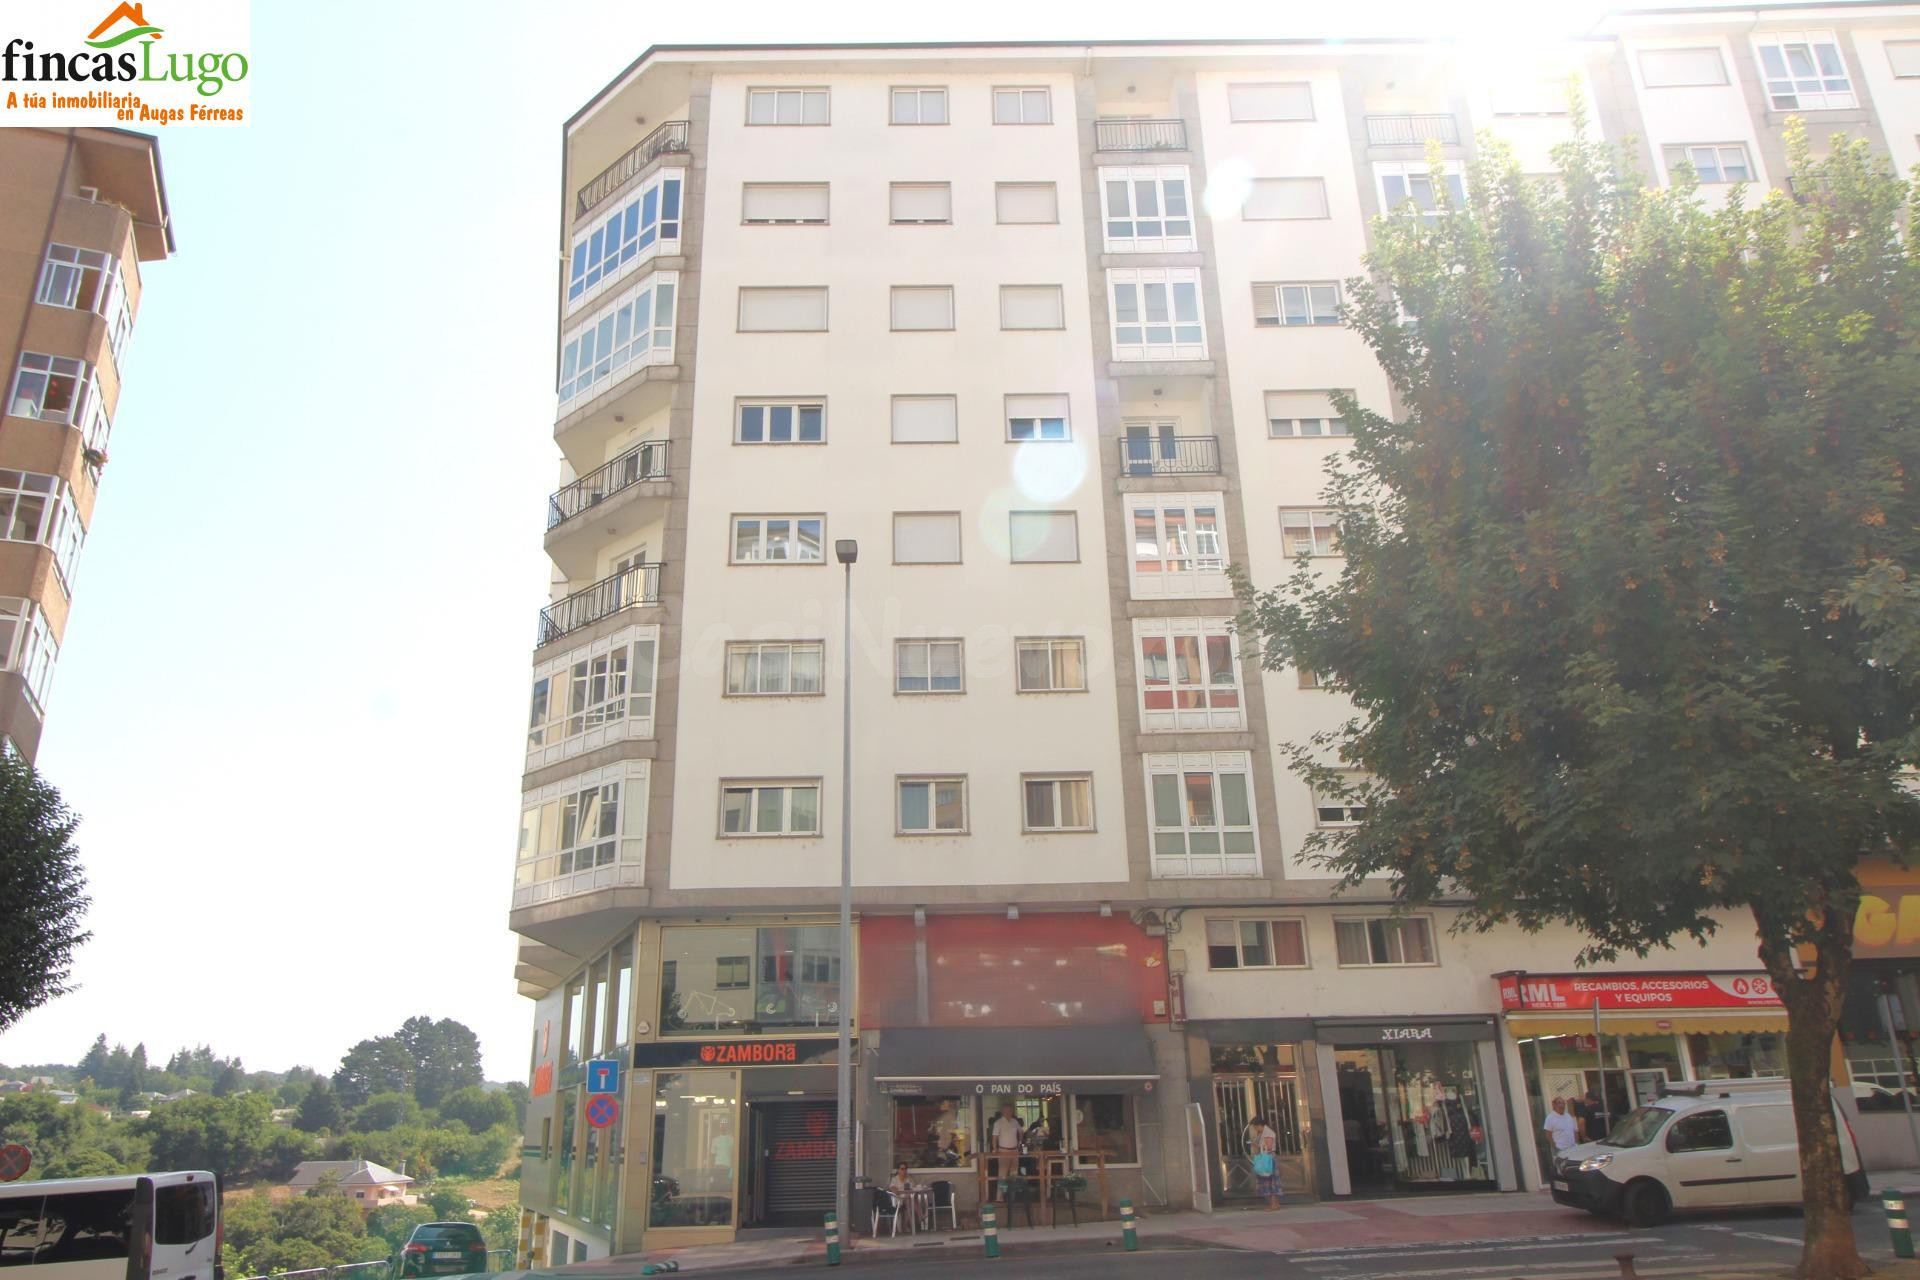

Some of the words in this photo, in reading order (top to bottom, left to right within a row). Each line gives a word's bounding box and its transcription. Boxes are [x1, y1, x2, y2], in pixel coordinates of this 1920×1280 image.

[1641, 980, 1710, 991] ACCESORIOS
[1614, 993, 1624, 1003] Y
[1625, 993, 1673, 1003] EQUIPOS
[1382, 1027, 1433, 1040] XIARA
[975, 1083, 985, 1094] O
[991, 1084, 1012, 1094] PAN
[1017, 1083, 1034, 1094] DO
[1040, 1081, 1061, 1094] PAÍS
